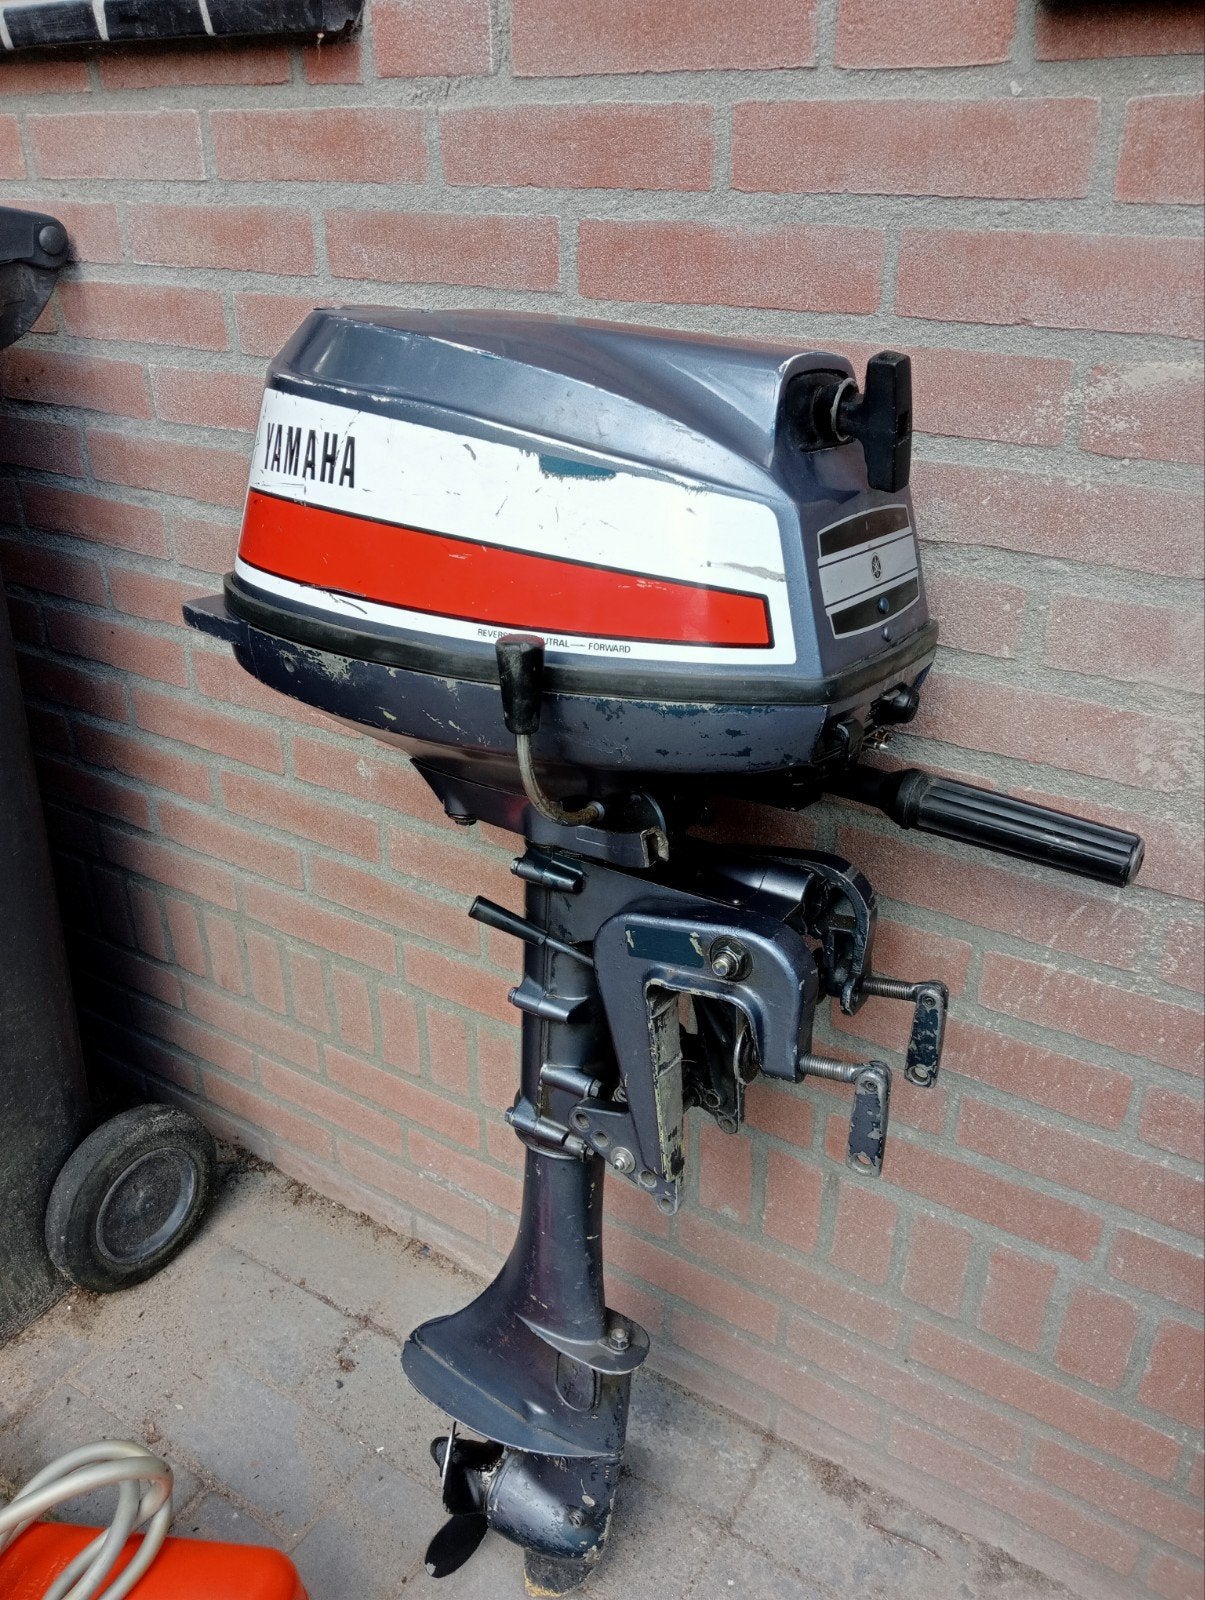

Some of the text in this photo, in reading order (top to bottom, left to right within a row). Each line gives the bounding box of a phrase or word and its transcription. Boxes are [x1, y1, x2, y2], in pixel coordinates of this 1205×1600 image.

[264, 422, 355, 489] YAMAHA
[477, 628, 512, 639] REVERS
[588, 642, 631, 654] FORWARD
